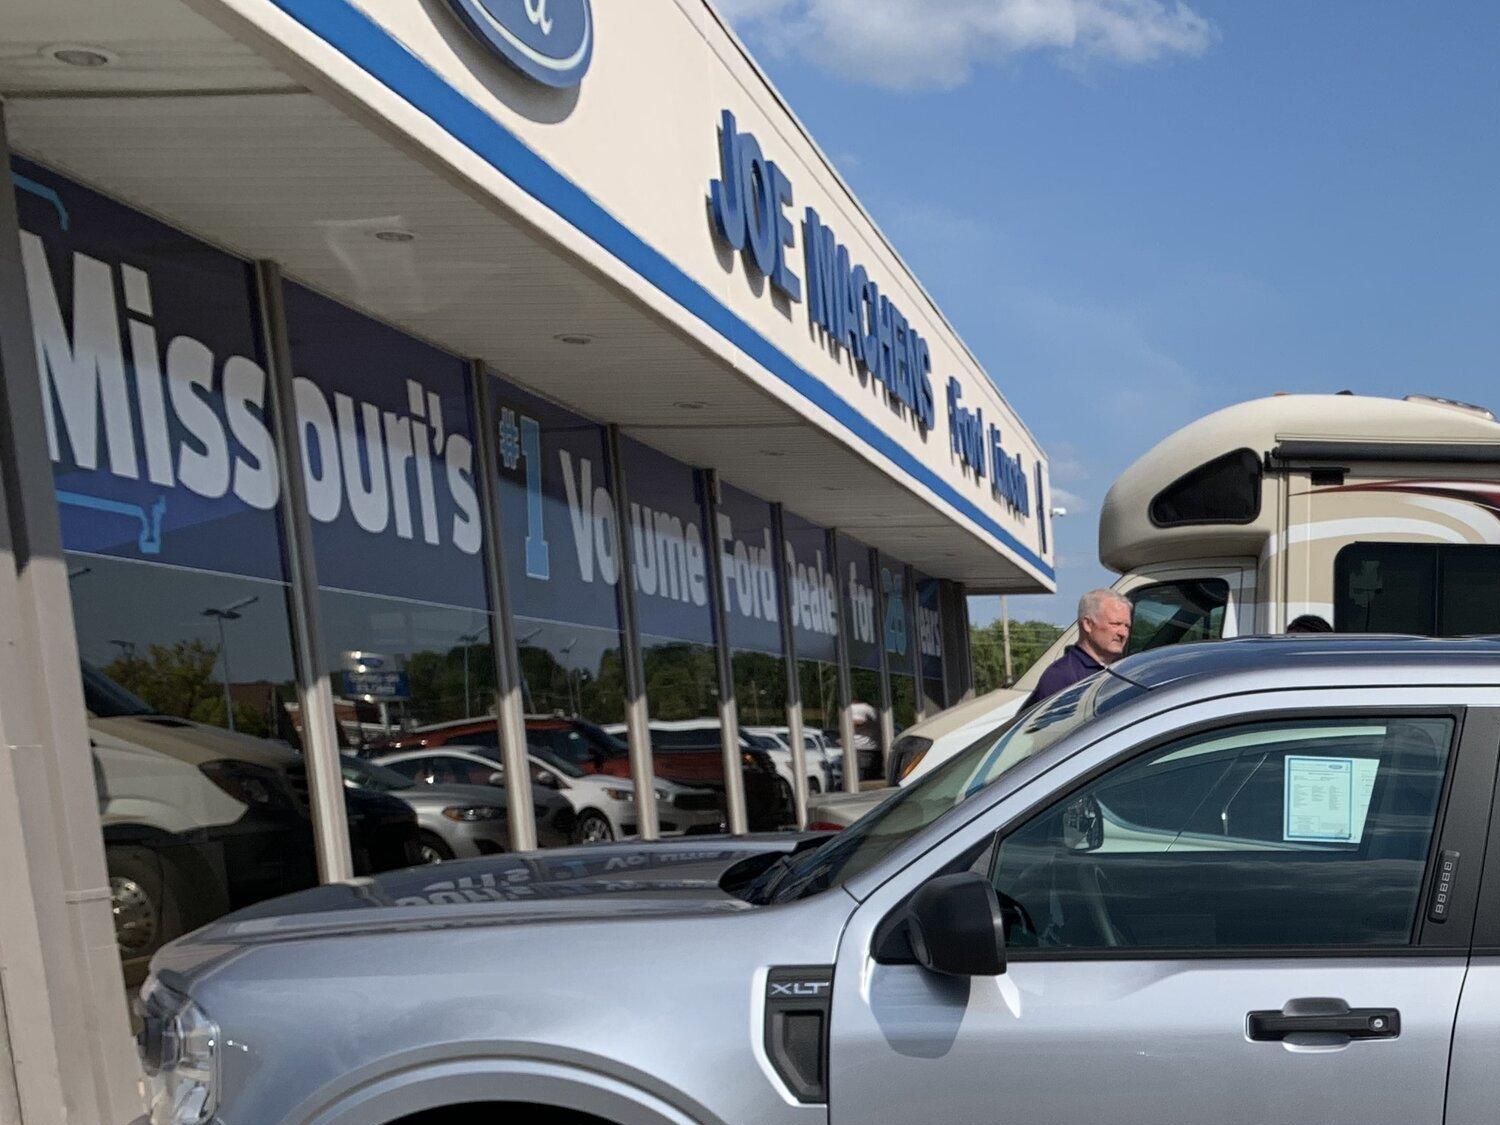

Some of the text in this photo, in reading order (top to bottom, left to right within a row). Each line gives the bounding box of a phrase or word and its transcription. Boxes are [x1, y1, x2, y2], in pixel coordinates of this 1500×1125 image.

[709, 109, 801, 304] JOE
[805, 207, 935, 431] MACHENS
[20, 229, 482, 554] Missouri's
[499, 407, 550, 580] #1
[559, 449, 708, 607] Voume
[716, 512, 778, 623] Ford
[785, 540, 838, 636] Deale
[850, 561, 876, 644] for
[770, 982, 830, 995] XLT
